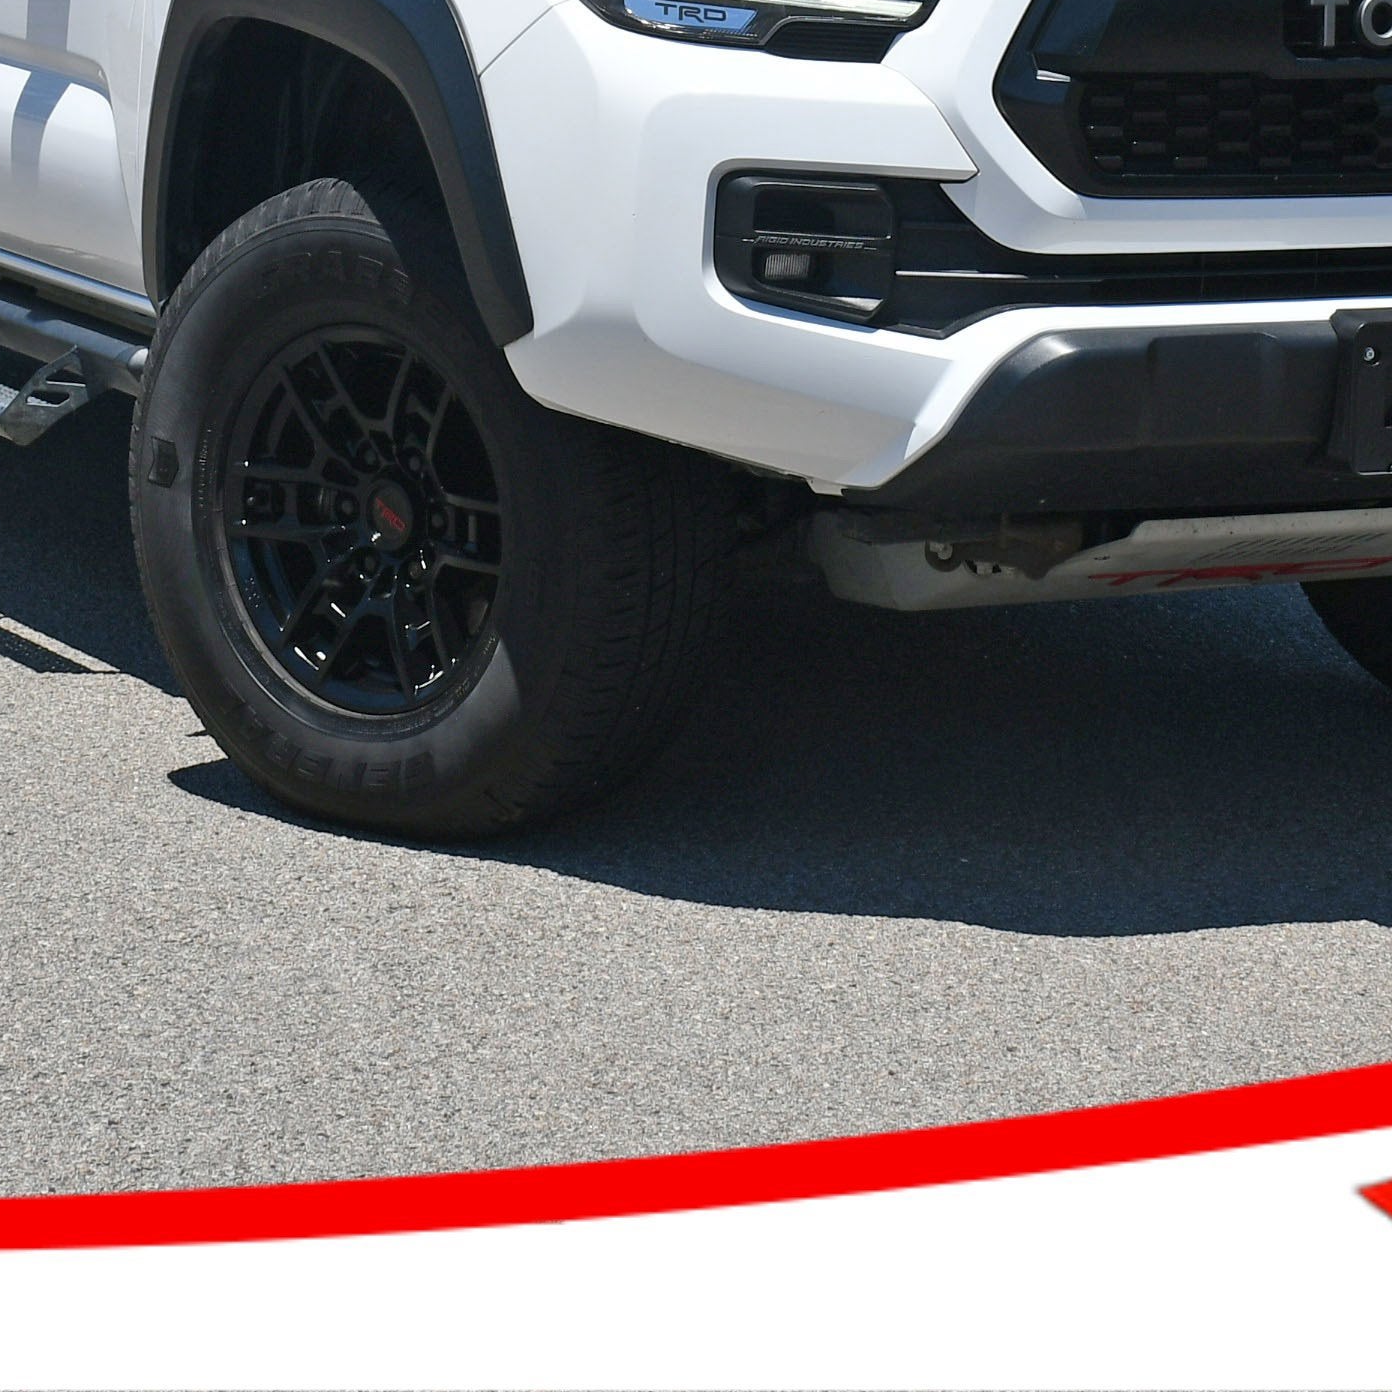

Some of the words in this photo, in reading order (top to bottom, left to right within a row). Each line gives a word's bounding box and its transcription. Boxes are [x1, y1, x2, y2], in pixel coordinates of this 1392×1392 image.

[654, 2, 726, 23] TRD
[754, 235, 790, 244] RIGID
[789, 237, 864, 249] INDUSTRIES
